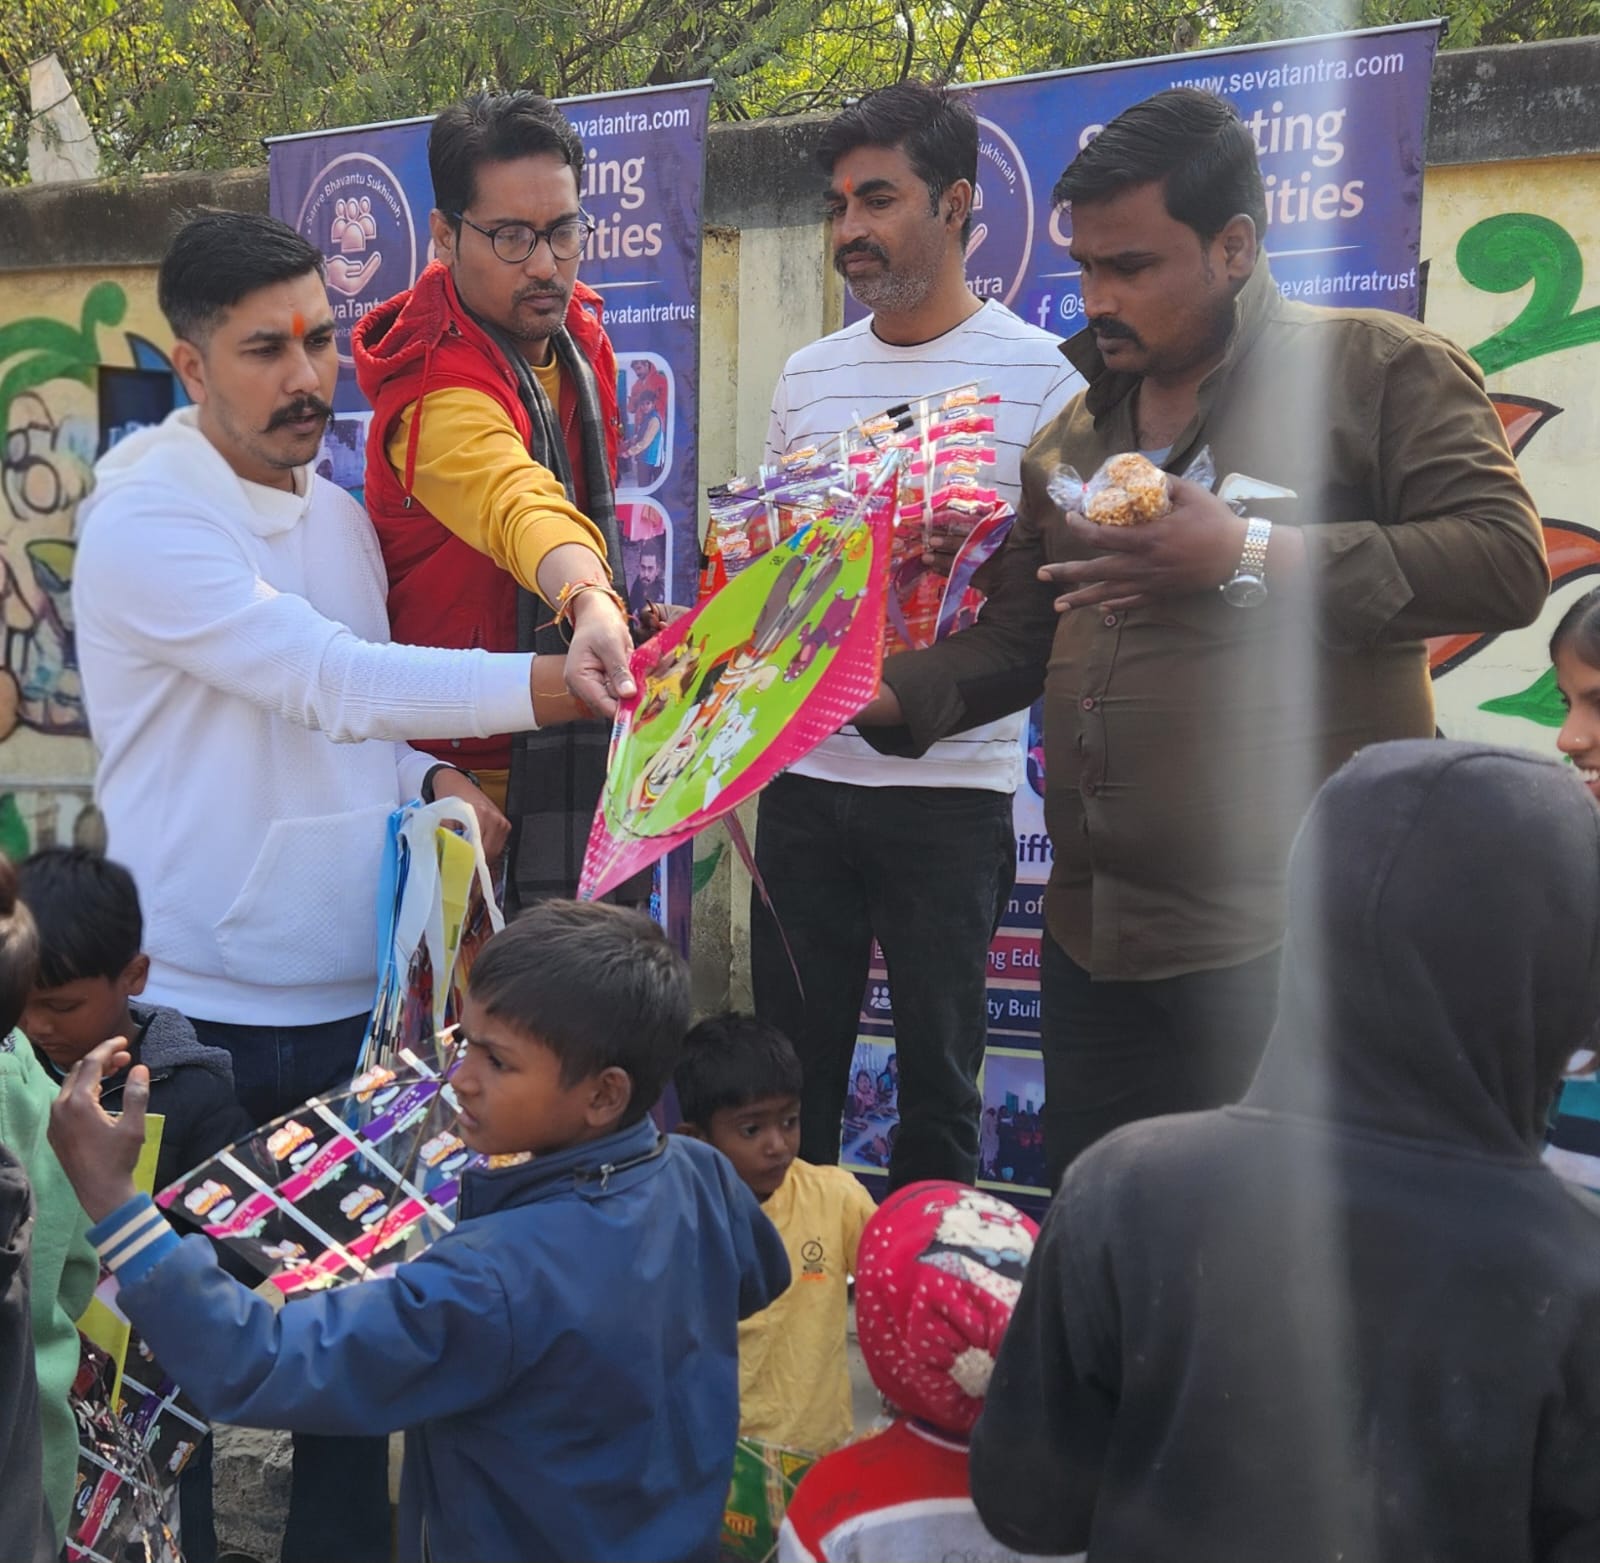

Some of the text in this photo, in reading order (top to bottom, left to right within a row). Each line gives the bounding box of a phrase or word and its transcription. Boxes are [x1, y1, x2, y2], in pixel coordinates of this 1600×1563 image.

[570, 108, 690, 138] evatantra.com
[1245, 100, 1347, 168] ting
[978, 139, 1017, 185] ukhinah
[324, 172, 366, 197] Bhavantu
[366, 174, 402, 218] Sukhinah
[1277, 267, 1417, 298] evatantratrust
[601, 302, 696, 325] evatantratrus
[1019, 833, 1055, 863] iff
